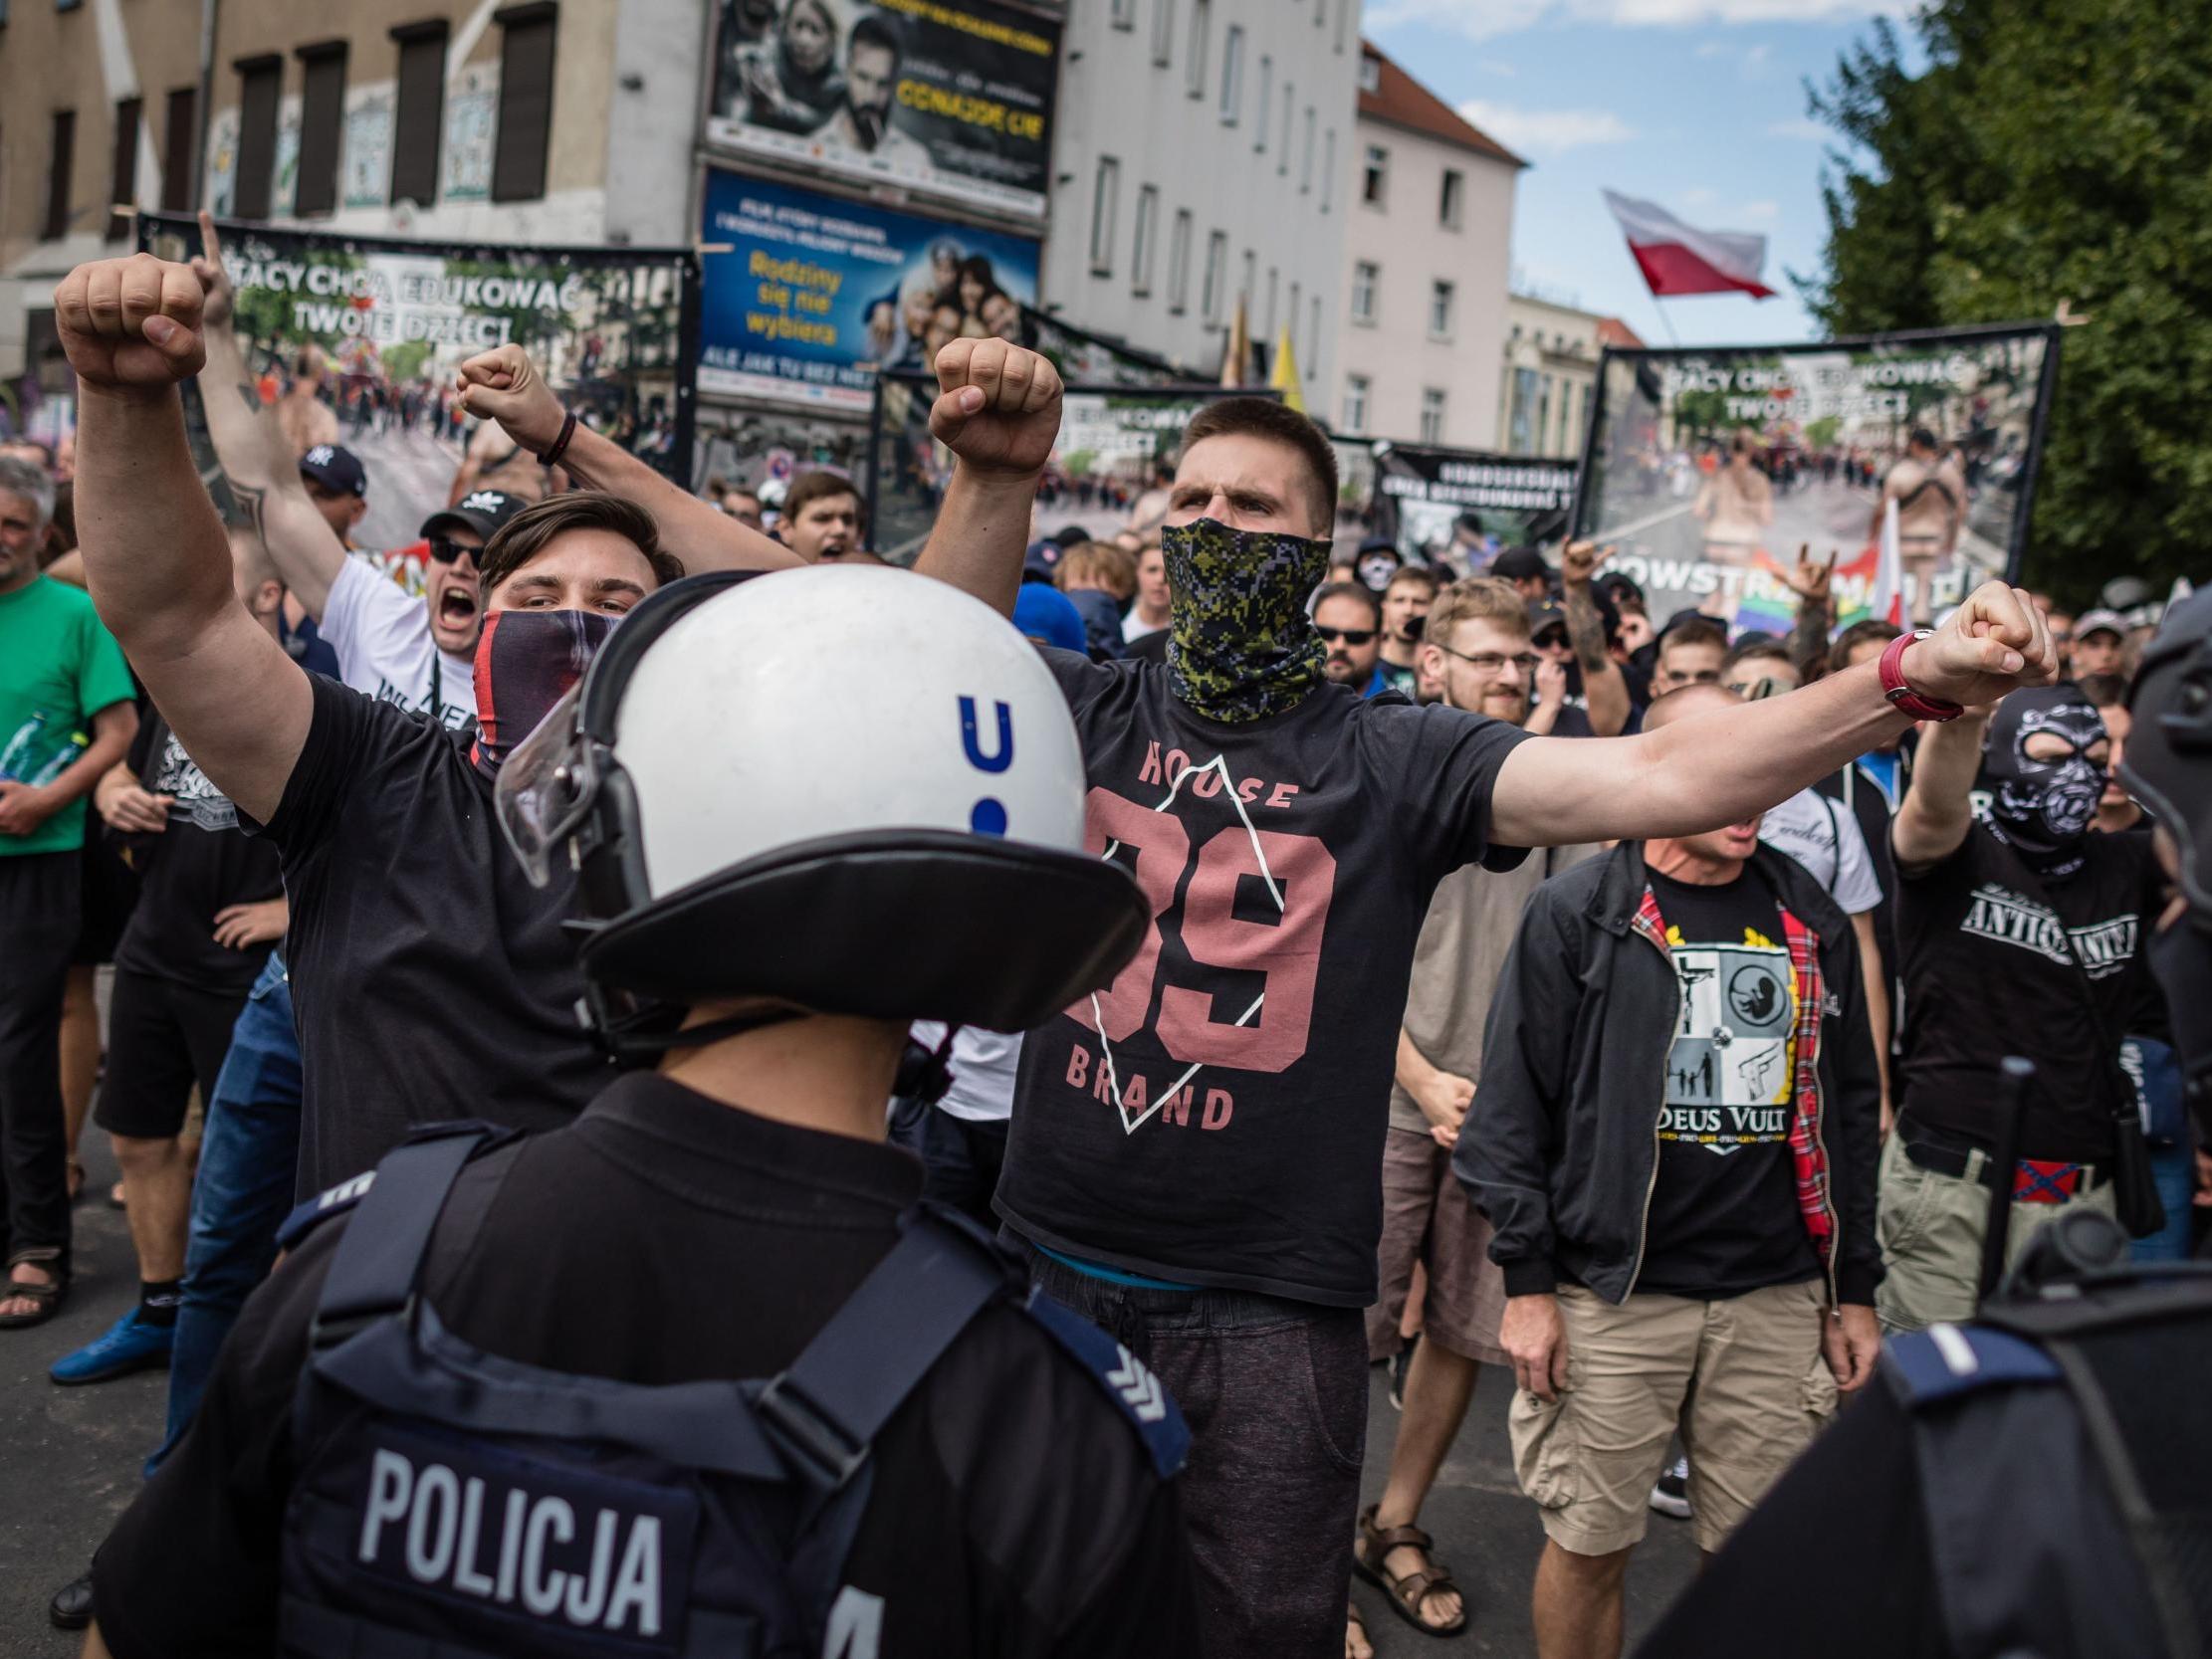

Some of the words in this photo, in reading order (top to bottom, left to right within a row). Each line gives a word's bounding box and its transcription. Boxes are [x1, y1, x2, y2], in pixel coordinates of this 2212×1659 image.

[402, 272, 584, 311] EDUKOWAĆ
[749, 250, 842, 296] Rodziny
[758, 282, 790, 310] się
[795, 290, 832, 315] nie
[294, 302, 395, 340] TWOJE
[404, 311, 513, 346] DZIECI
[746, 311, 837, 347] wybiera
[1138, 739, 1301, 808] HOUSE
[1065, 1043, 1234, 1132] BRAND
[1657, 1108, 1722, 1133] DEUS
[1726, 1106, 1786, 1133] VULT
[357, 1446, 663, 1638] POLICJA
